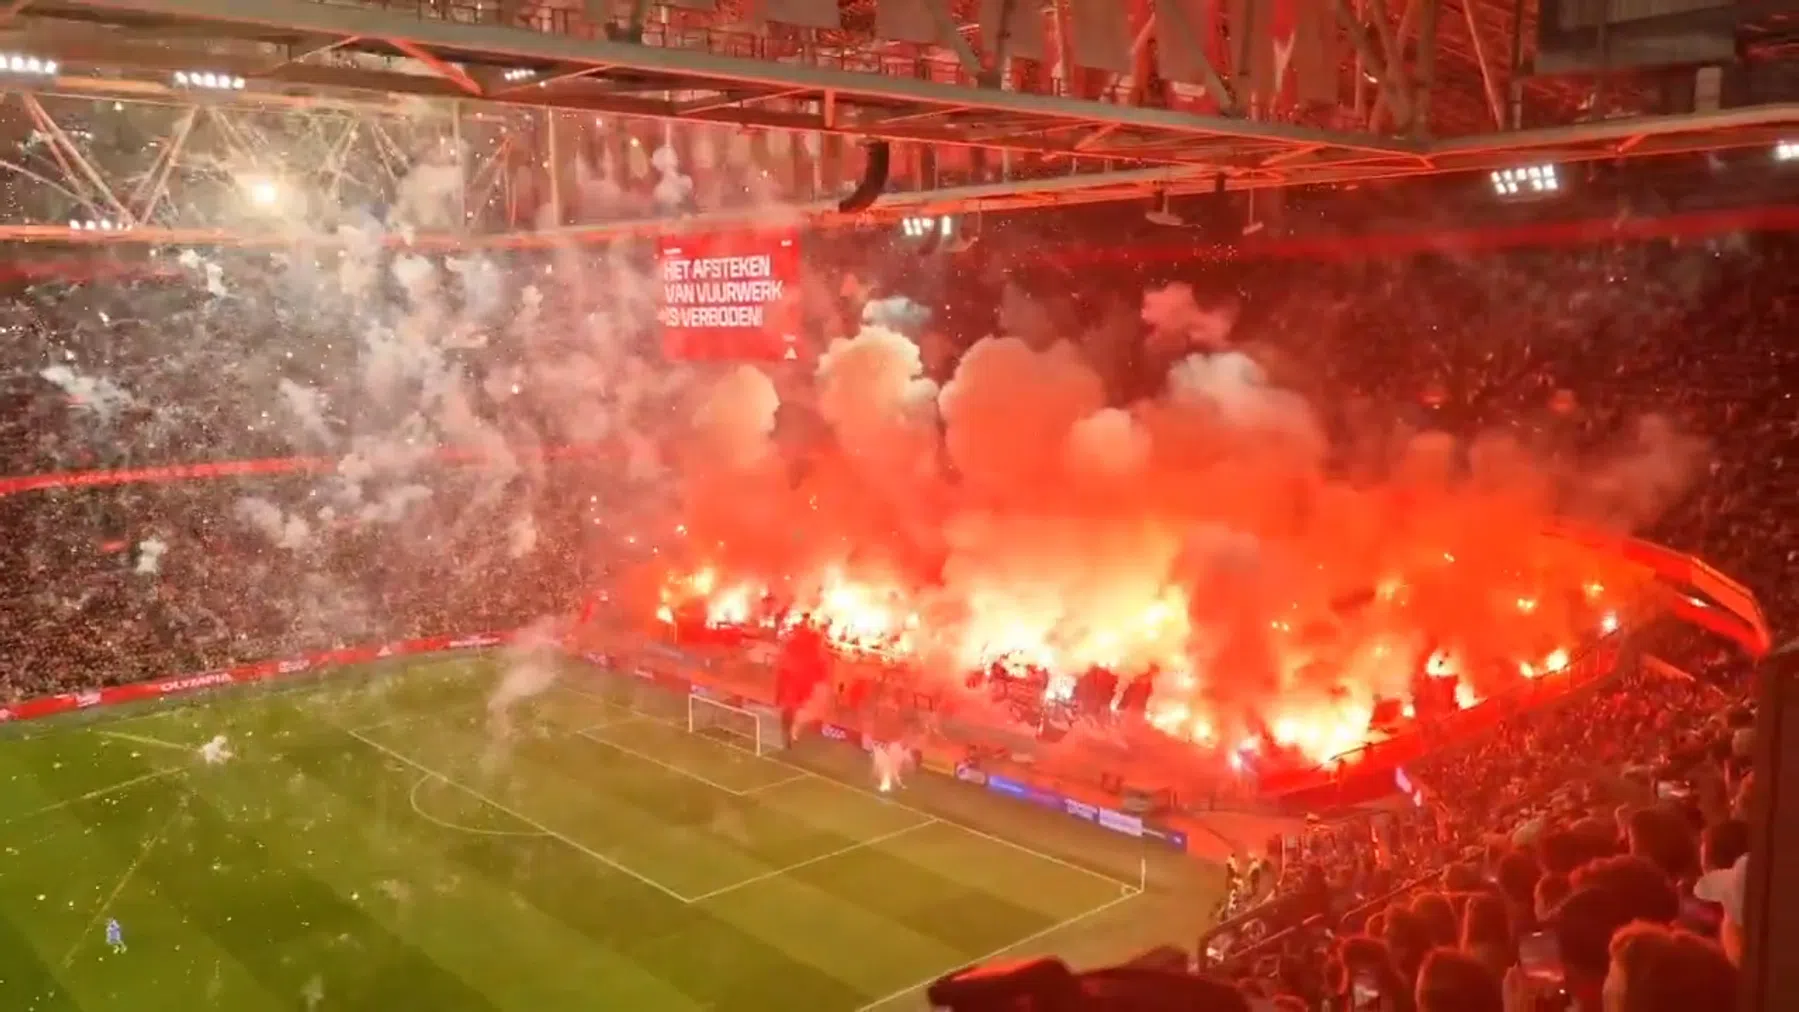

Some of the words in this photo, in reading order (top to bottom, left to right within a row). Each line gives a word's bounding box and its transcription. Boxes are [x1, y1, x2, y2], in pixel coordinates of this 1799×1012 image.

[665, 260, 690, 280] HET
[693, 255, 770, 279] AFSTEKEN
[665, 283, 694, 303] VAN
[696, 280, 783, 303] VUURWERK
[160, 673, 232, 692] OLYMPIA
